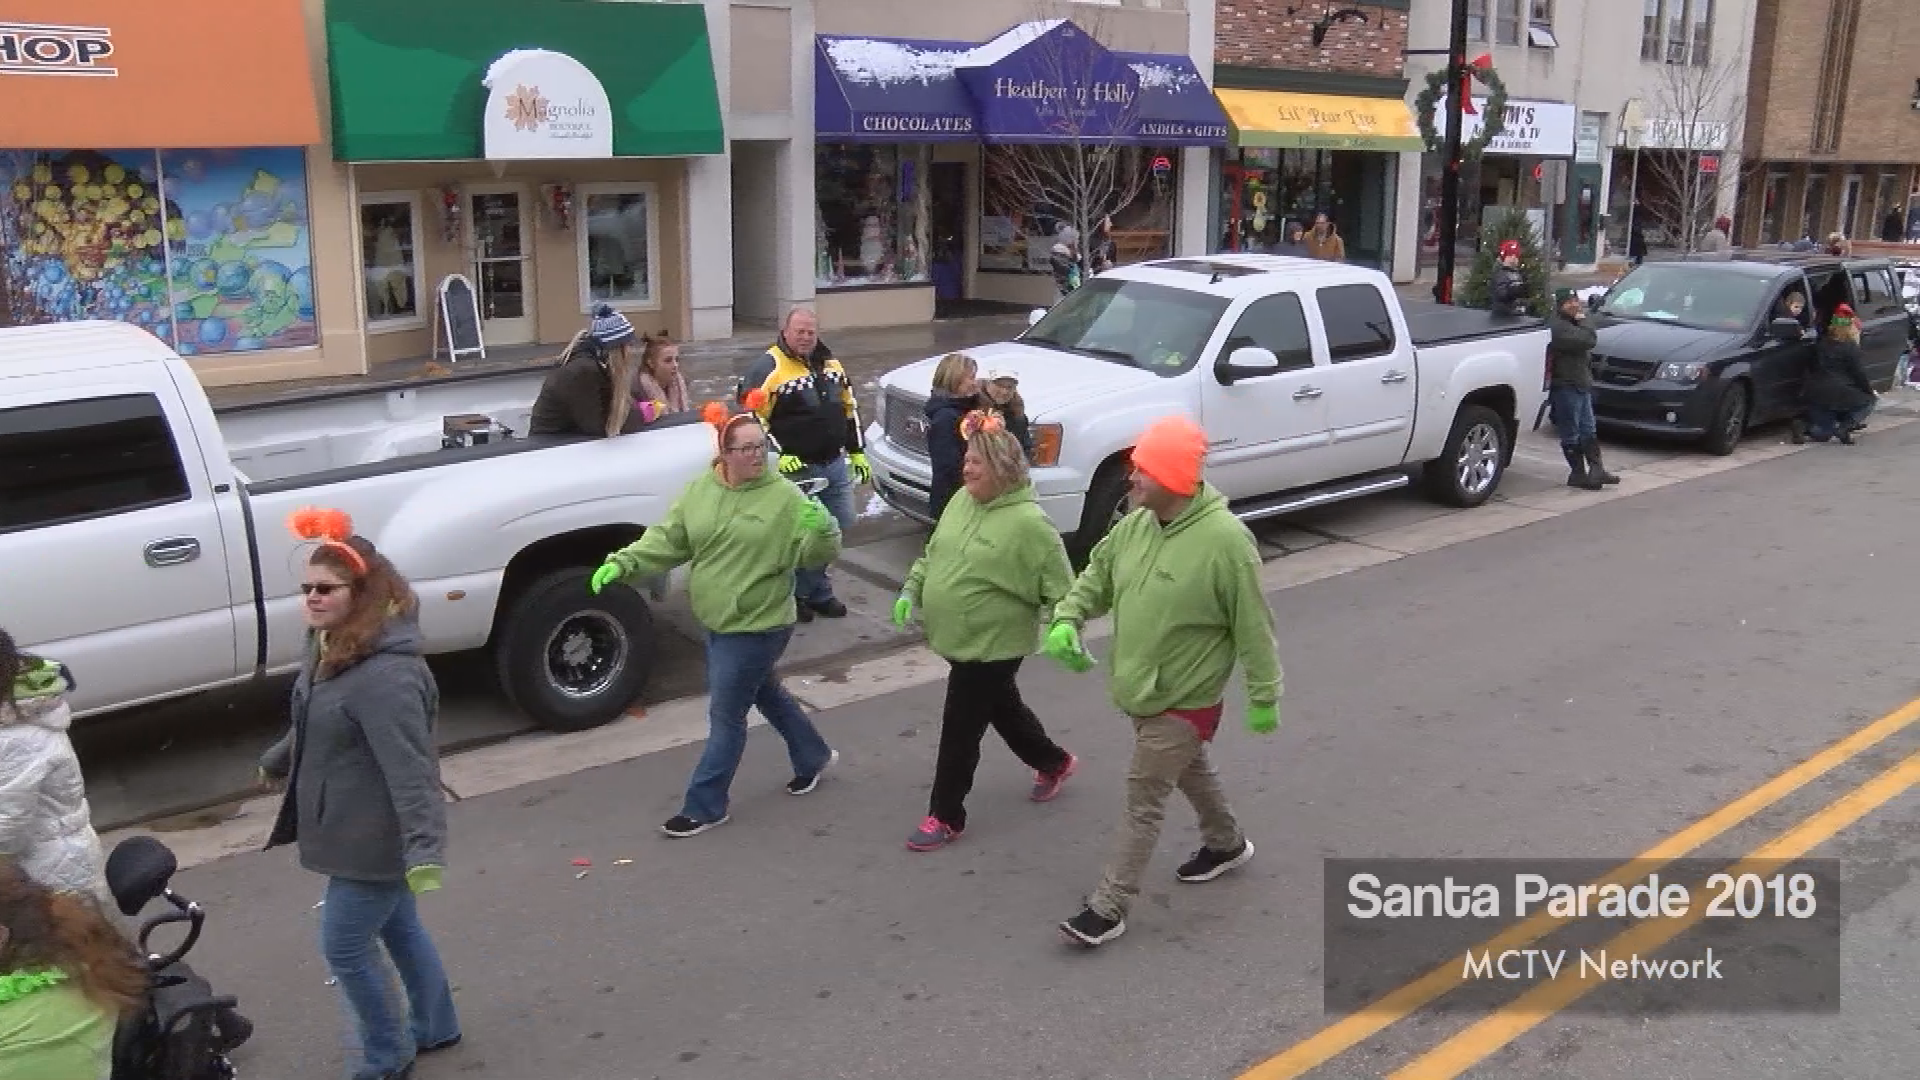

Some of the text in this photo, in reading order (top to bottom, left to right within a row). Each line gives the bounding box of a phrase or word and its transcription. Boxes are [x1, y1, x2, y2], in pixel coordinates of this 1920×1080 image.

[994, 77, 1067, 105] Heather
[1093, 81, 1134, 109] Holly
[519, 97, 596, 122] Magnolia
[863, 116, 972, 132] CHOCOLATES
[1194, 125, 1227, 137] GIFTS
